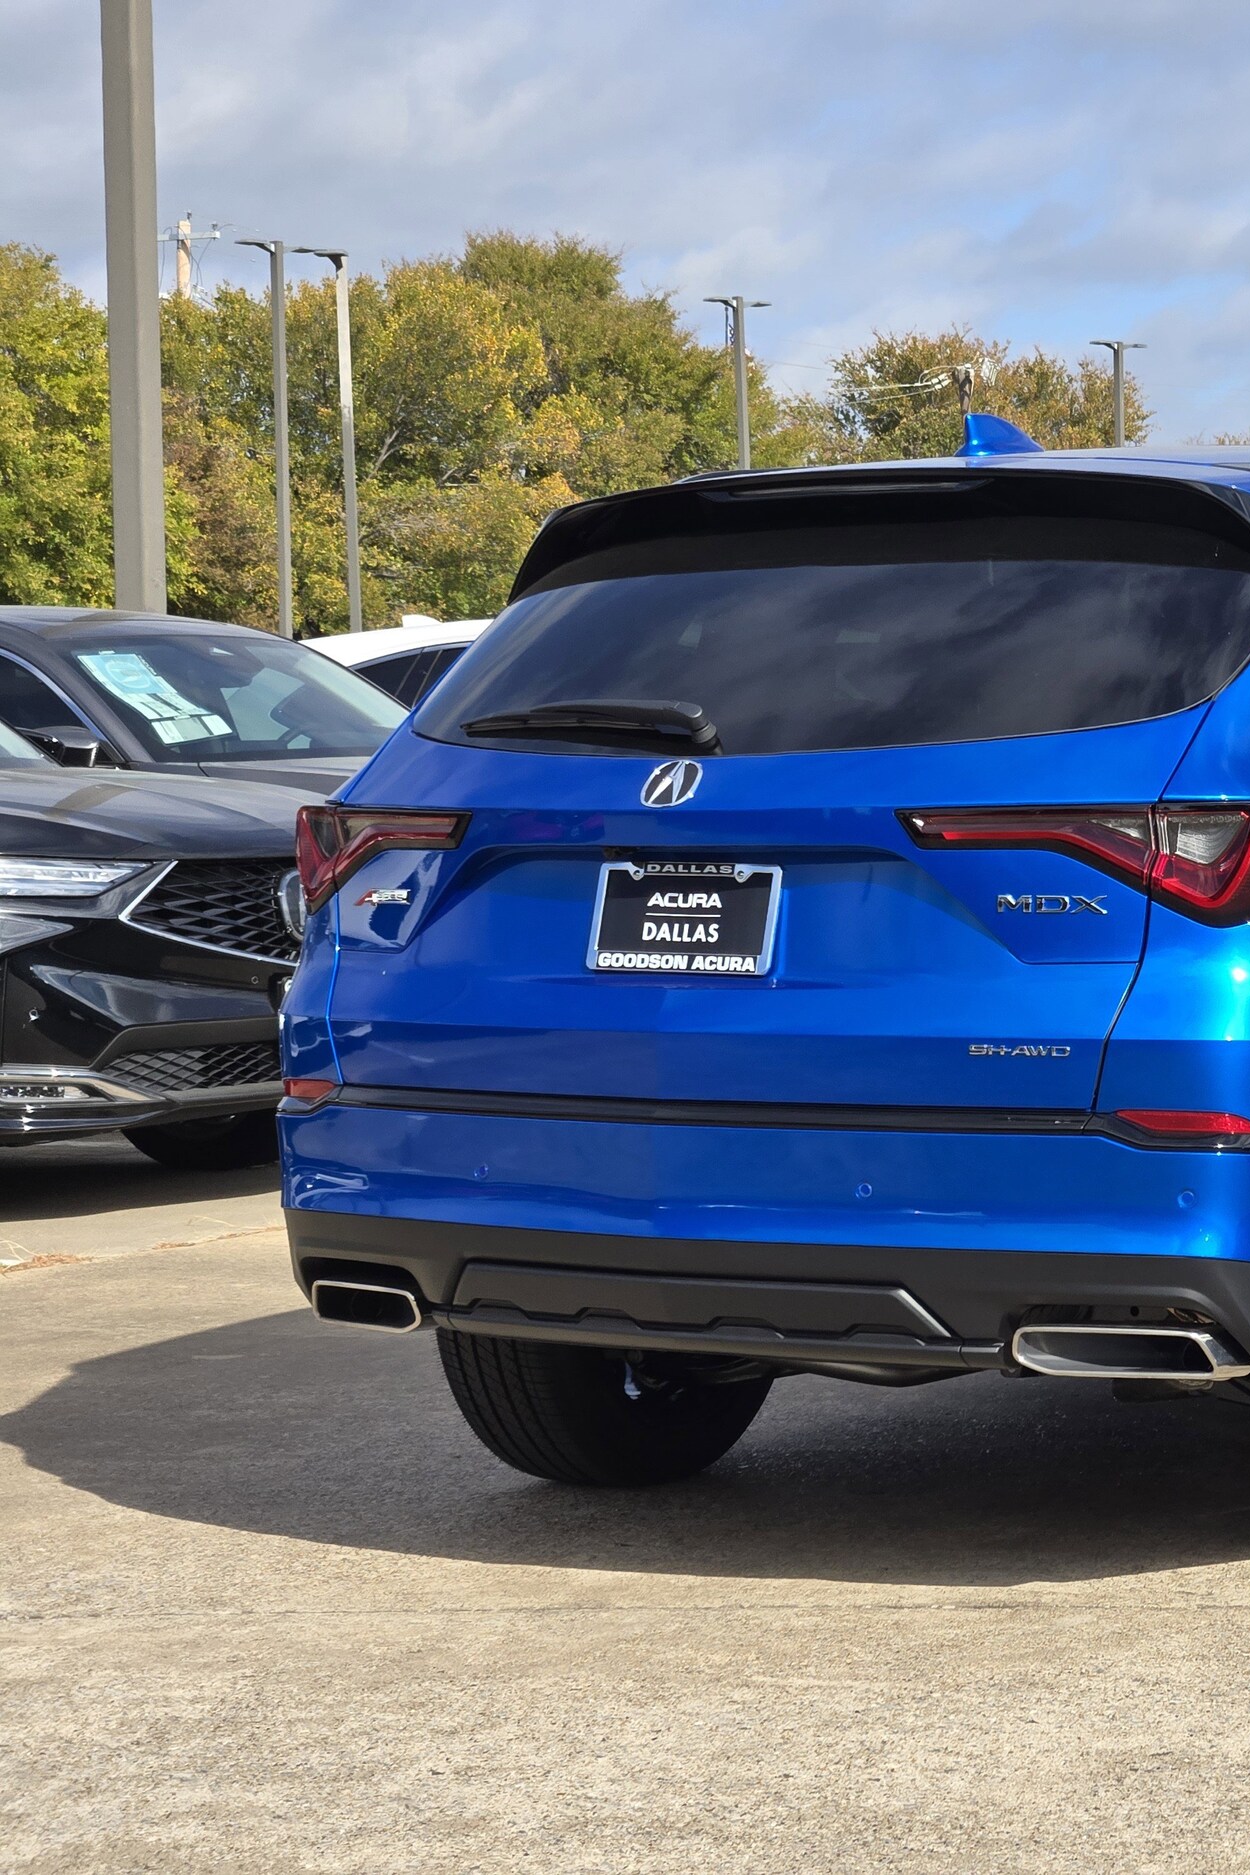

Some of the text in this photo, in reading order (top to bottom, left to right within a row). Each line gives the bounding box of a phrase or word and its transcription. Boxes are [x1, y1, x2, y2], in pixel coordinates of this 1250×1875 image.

[646, 863, 733, 874] DALLAS
[647, 892, 722, 908] ACURA
[996, 894, 1108, 915] MDX
[642, 922, 720, 943] DALLAS
[597, 952, 756, 972] GOODSON ACURA
